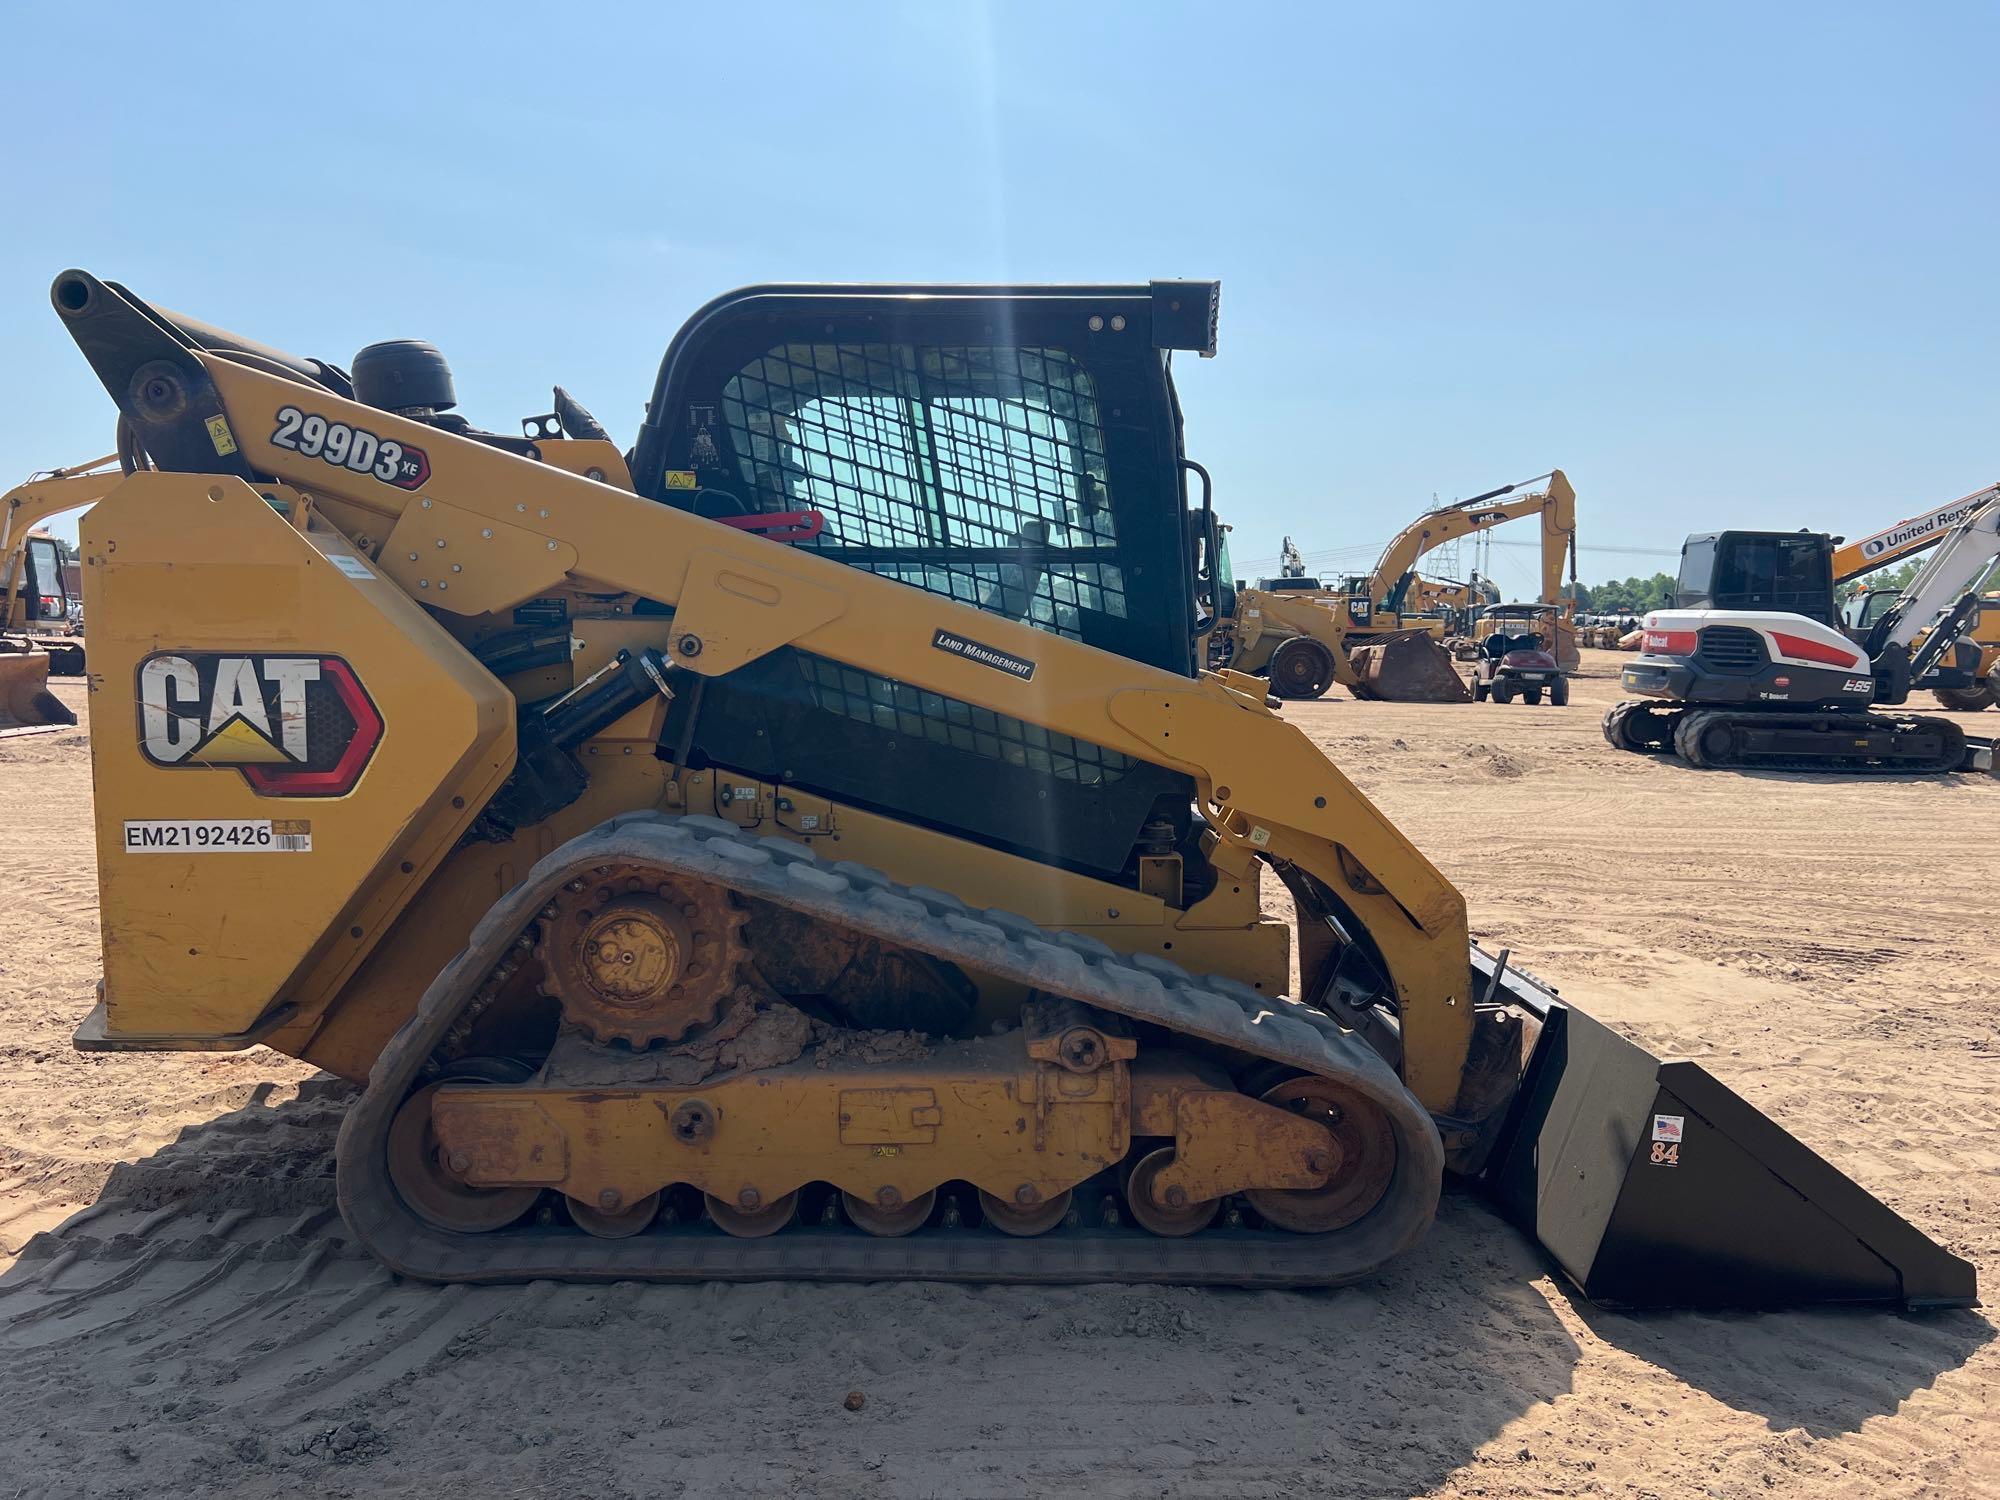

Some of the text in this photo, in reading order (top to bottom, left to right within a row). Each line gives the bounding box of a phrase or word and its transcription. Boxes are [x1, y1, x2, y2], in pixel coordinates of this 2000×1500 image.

[272, 407, 419, 481] 299D3 XE
[1886, 518, 1935, 547] United
[1351, 601, 1369, 613] CAT
[1649, 634, 1668, 648] Bobcat
[1768, 692, 1789, 700] Bobcat
[1842, 679, 1873, 693] E85
[141, 655, 321, 763] CAT
[126, 825, 272, 847] EM2192426
[1650, 1141, 1679, 1164] 84
